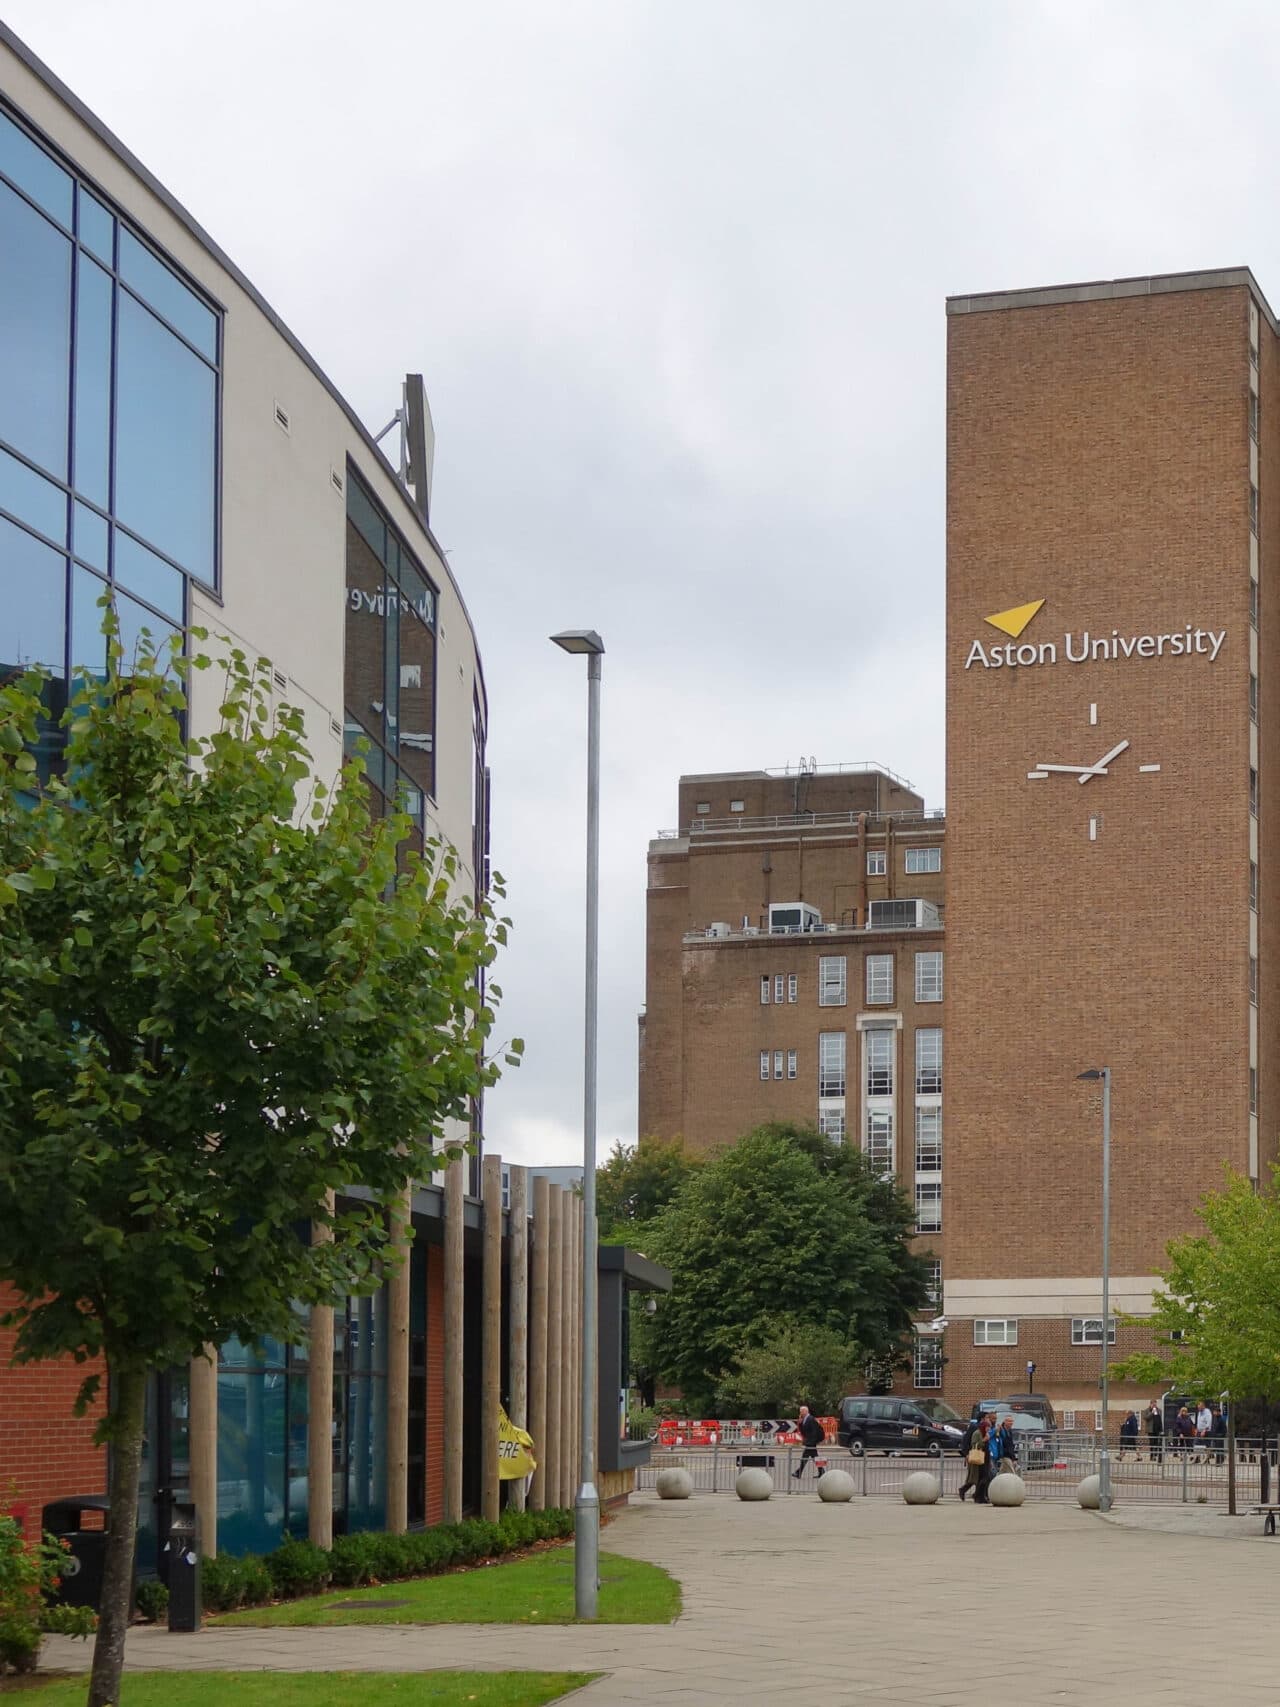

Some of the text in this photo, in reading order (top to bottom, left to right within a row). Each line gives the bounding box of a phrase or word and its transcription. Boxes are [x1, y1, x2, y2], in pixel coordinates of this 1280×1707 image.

[964, 624, 1227, 669] Aston University
[499, 1440, 519, 1458] ERE
